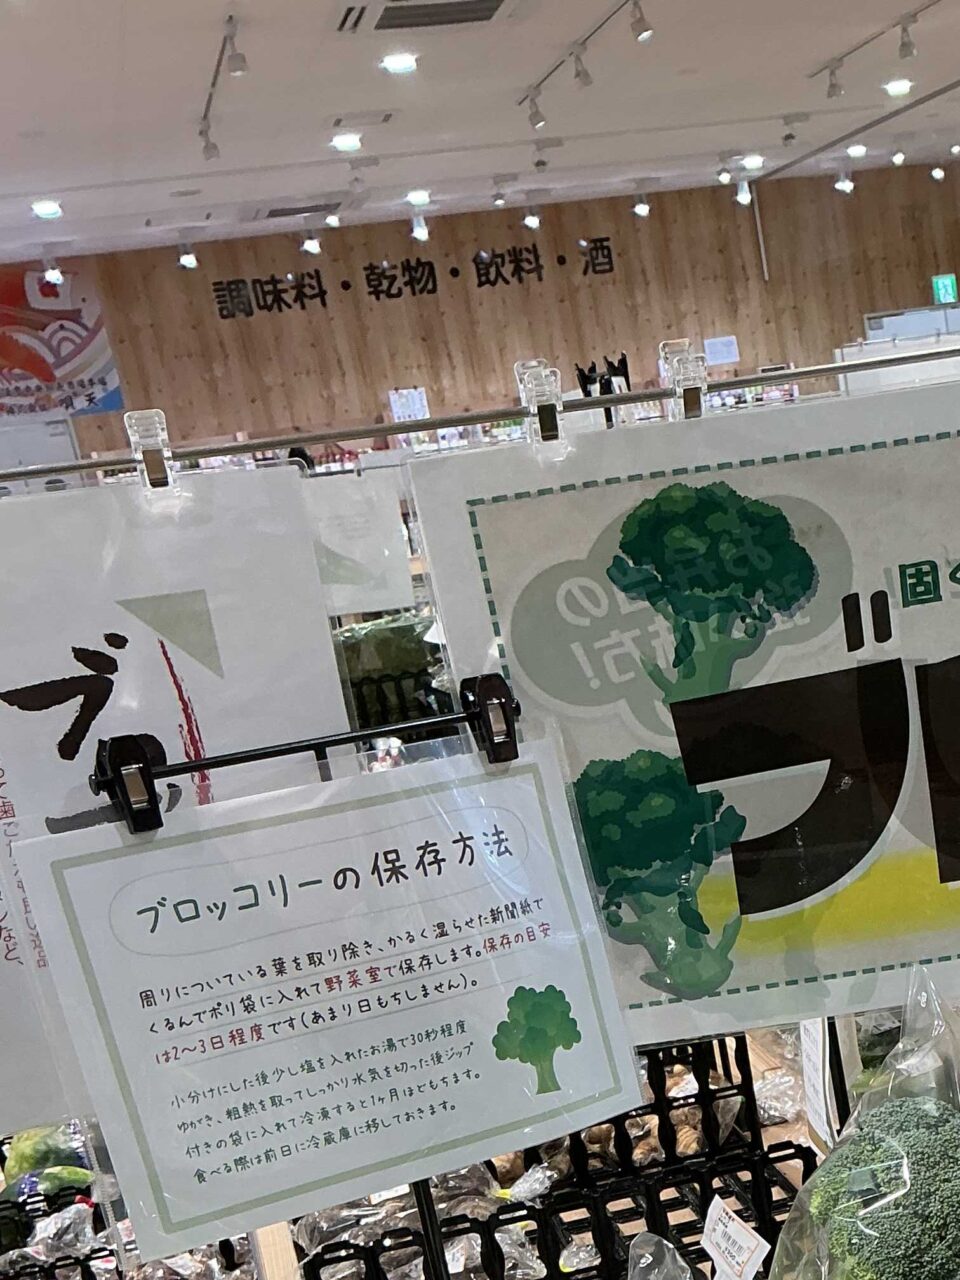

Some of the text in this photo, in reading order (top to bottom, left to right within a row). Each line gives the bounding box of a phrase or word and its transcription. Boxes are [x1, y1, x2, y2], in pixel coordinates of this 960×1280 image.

[212, 237, 614, 319] 調味料・乾物・飲料・酒
[136, 825, 513, 934] ブロッコリーの保存方法
